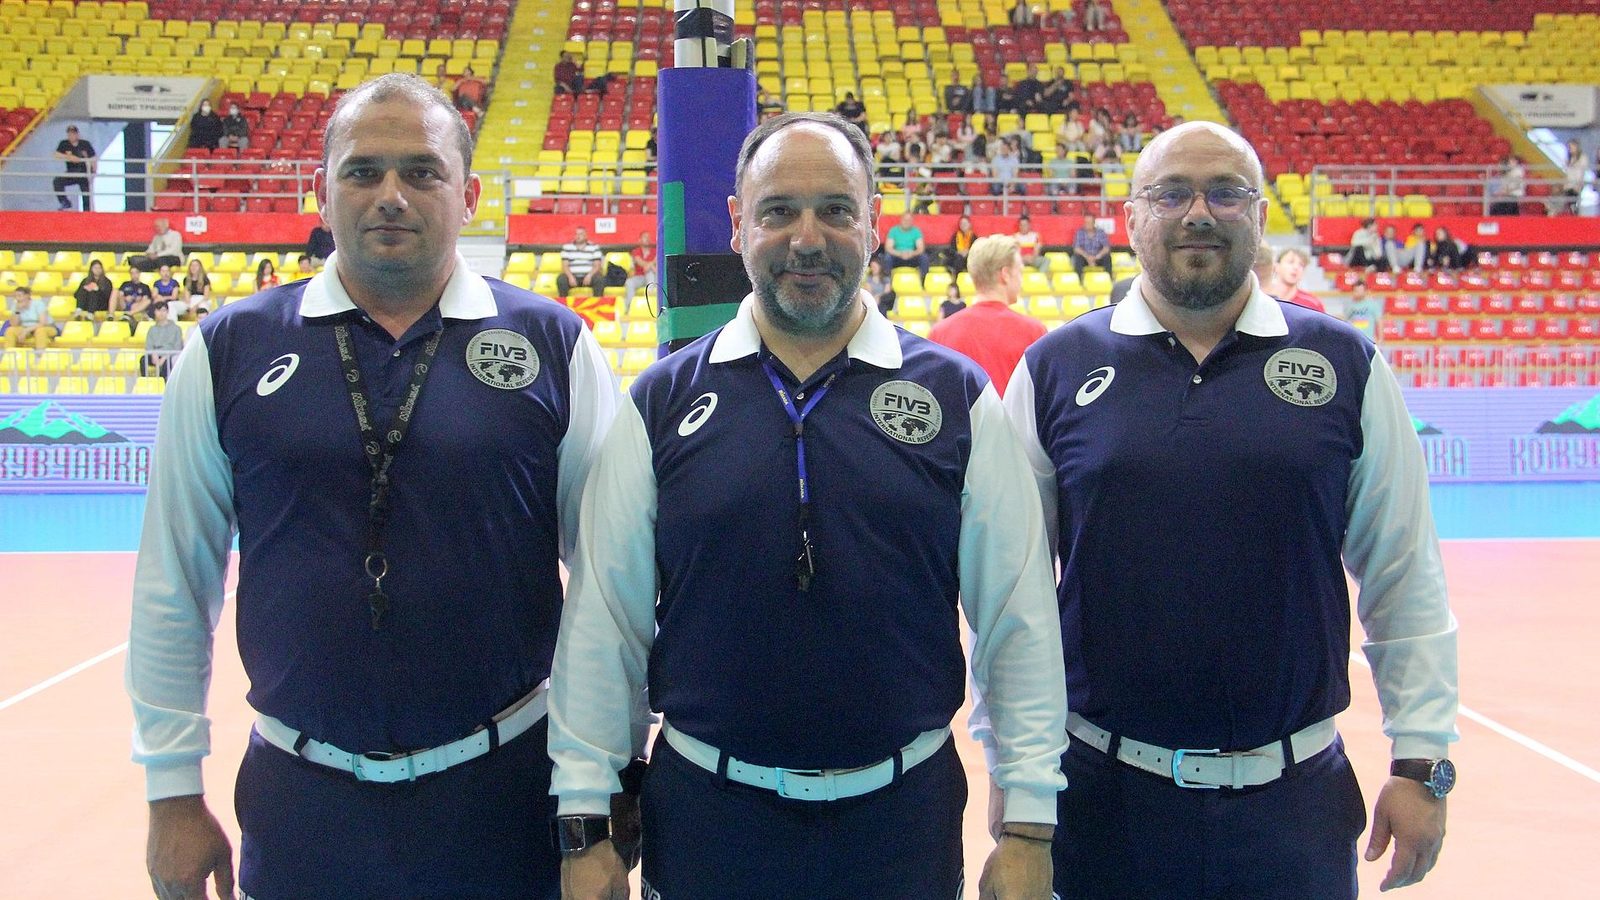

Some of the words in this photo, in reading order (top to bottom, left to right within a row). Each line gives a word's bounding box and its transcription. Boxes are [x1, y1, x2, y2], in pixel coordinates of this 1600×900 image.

[480, 342, 527, 361] FIVB
[469, 362, 515, 388] INTERNATIONAL
[515, 372, 536, 388] REFEREE
[1278, 360, 1325, 379] FIVB
[883, 392, 931, 416] FIVB
[1268, 380, 1314, 406] INTERNATIONAL
[1313, 391, 1334, 406] REFEREE
[872, 411, 917, 443] INTERNATIONAL
[916, 428, 937, 443] REFEREE
